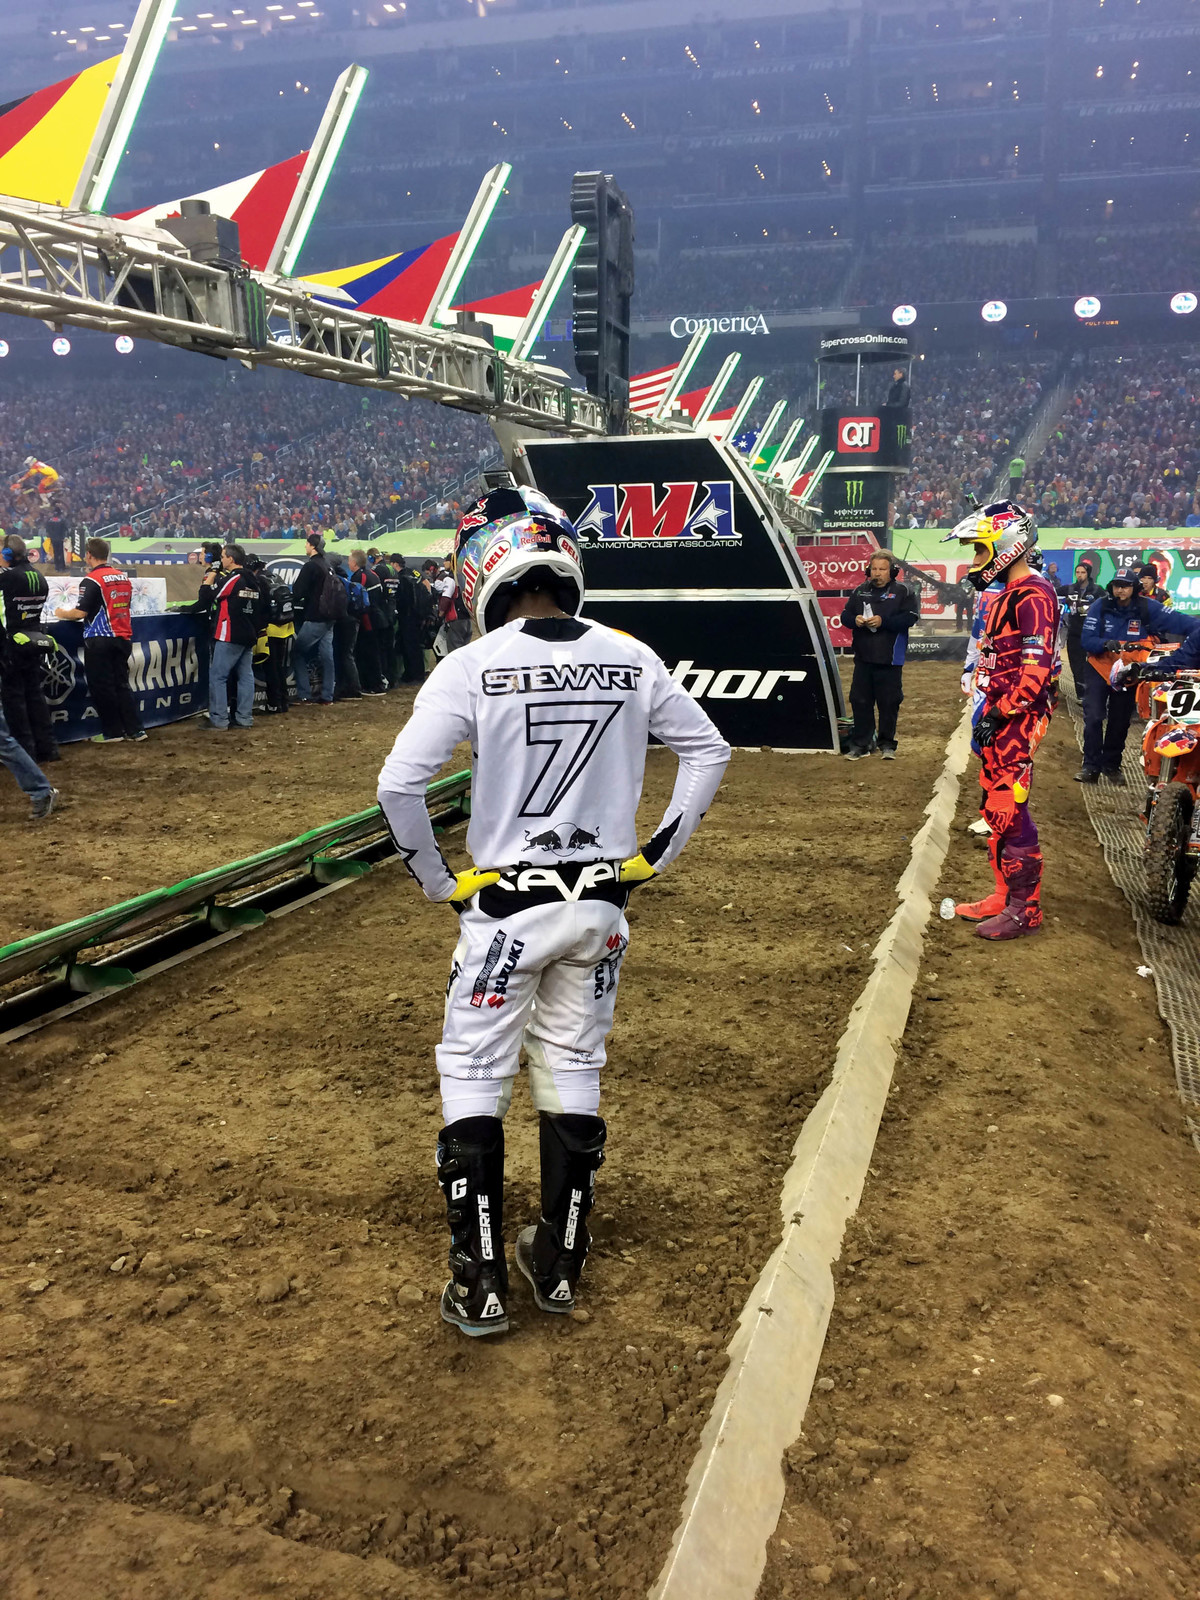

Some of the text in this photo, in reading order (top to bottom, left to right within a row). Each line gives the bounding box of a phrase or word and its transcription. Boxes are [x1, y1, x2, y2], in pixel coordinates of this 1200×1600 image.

[820, 334, 908, 349] SupercrossOnline.com
[841, 421, 874, 447] QT
[573, 480, 743, 541] AMA
[823, 520, 885, 528] SUPERCROSS
[833, 508, 875, 516] MONSTER
[578, 539, 743, 550] RICAN MOTORCYCLIST ASSOCIATION
[484, 545, 509, 573] BELL
[819, 558, 871, 574] TOYOT
[981, 541, 1026, 583] Red Bull
[1117, 554, 1138, 567] 1st
[977, 651, 997, 670] Bull
[481, 664, 643, 696] STEWART
[667, 659, 807, 700] hor
[50, 693, 192, 724] RAING
[1170, 690, 1200, 718] 9
[517, 700, 625, 818] 7
[494, 939, 525, 995] SUZUKI
